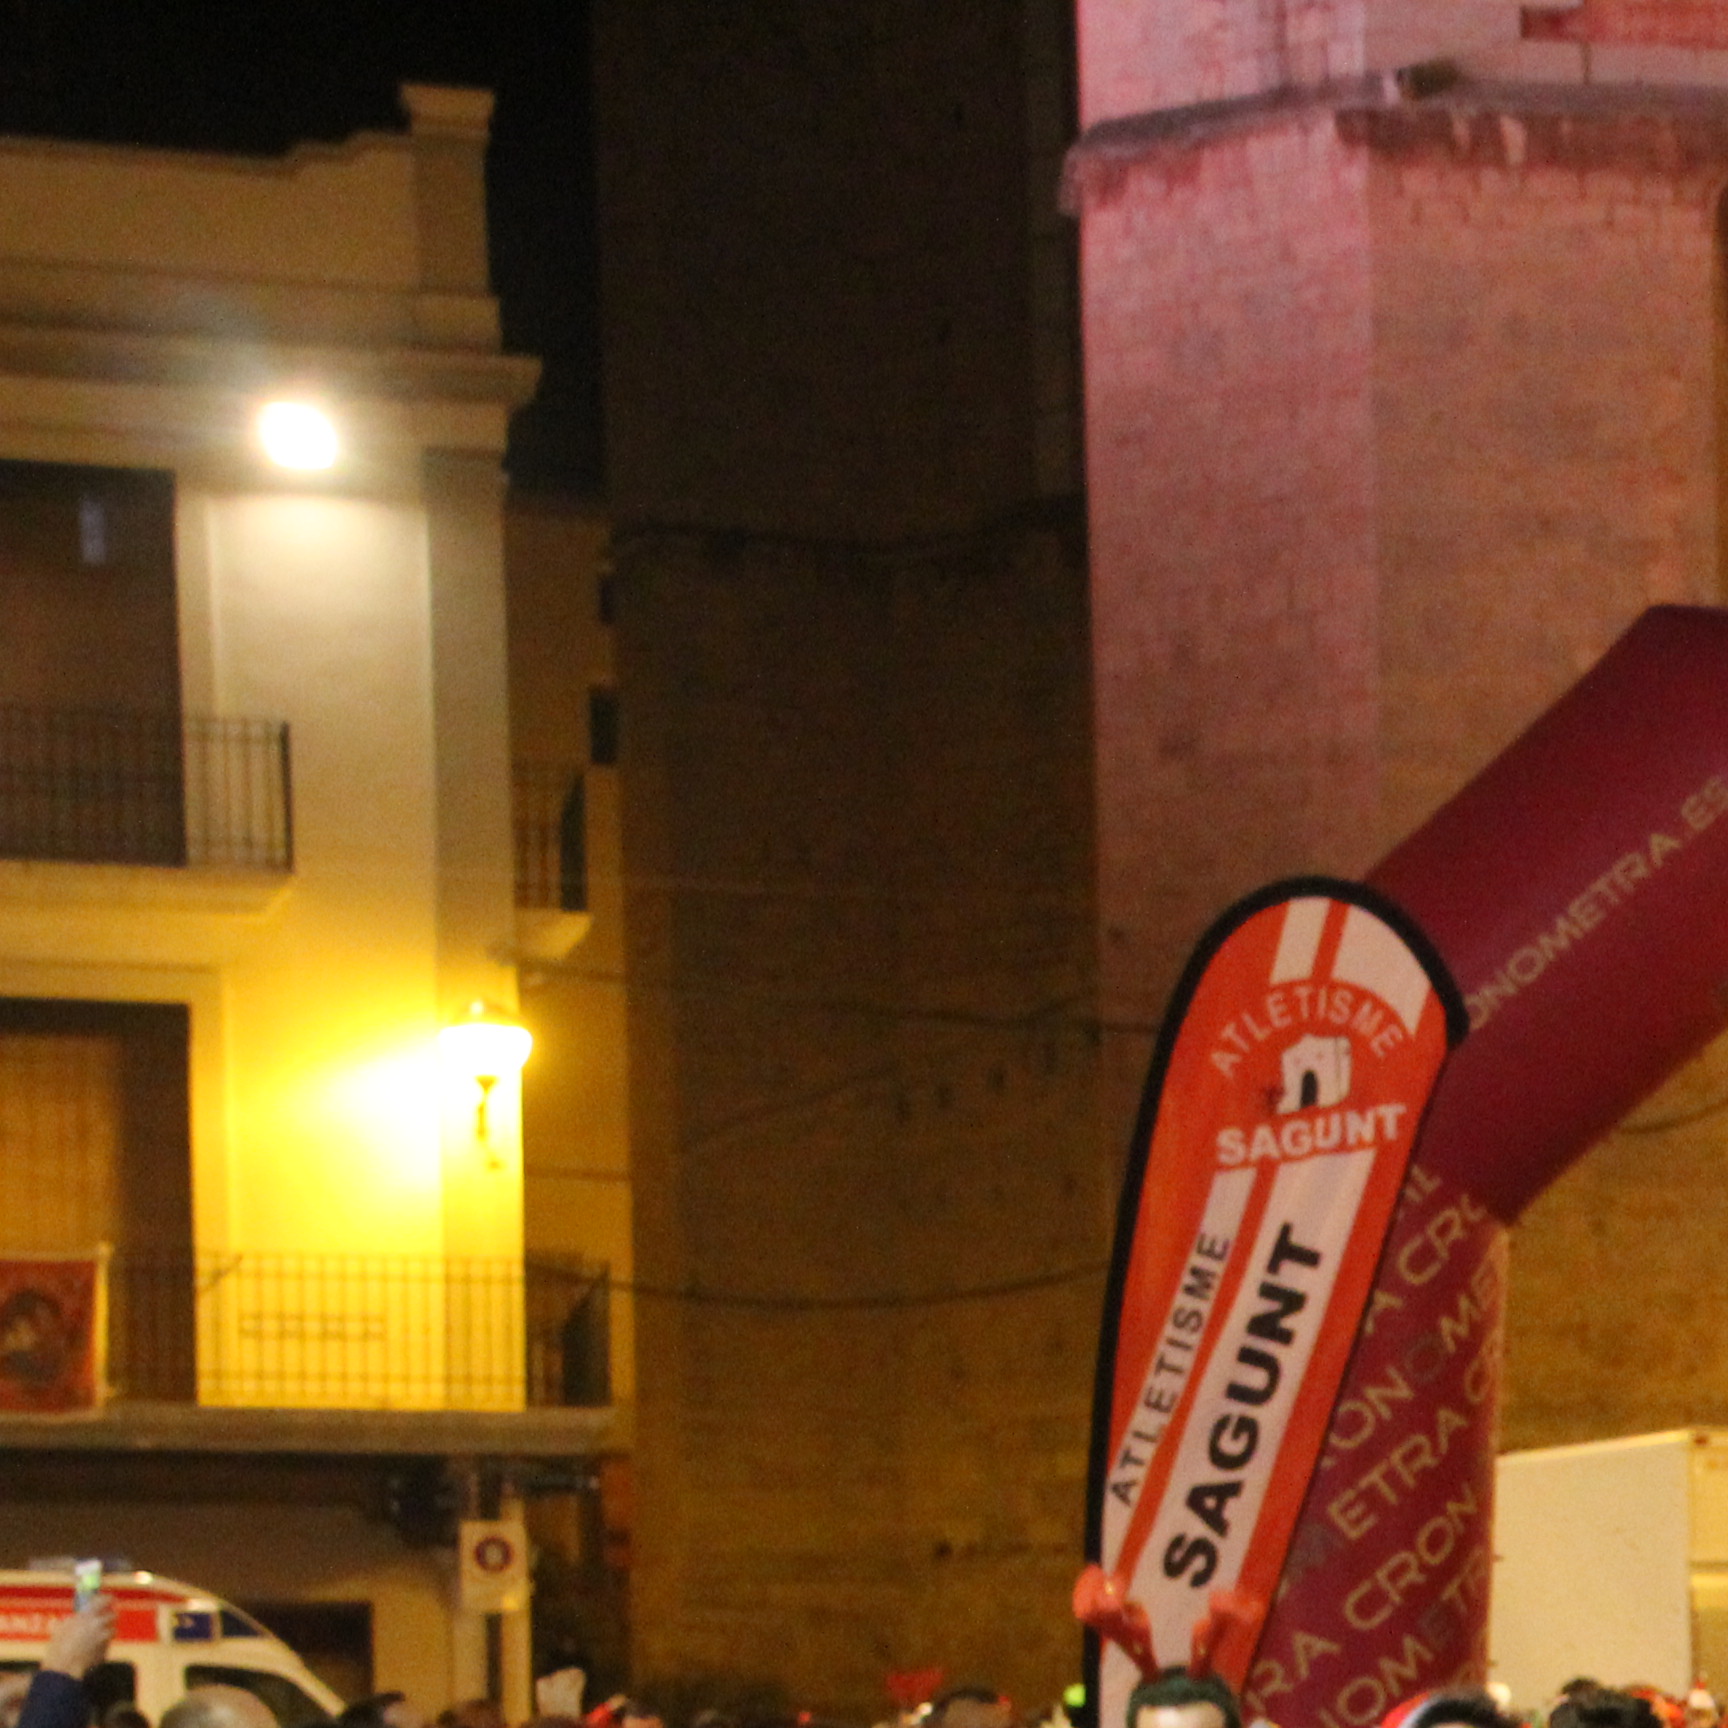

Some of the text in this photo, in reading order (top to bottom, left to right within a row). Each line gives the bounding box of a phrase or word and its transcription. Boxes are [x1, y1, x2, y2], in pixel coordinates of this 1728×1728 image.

[1211, 984, 1405, 1082] ATLETISME
[1216, 1103, 1407, 1165] SAGUNT
[1110, 1233, 1232, 1507] ATLETISME
[1162, 1221, 1321, 1588] SAGUNT
